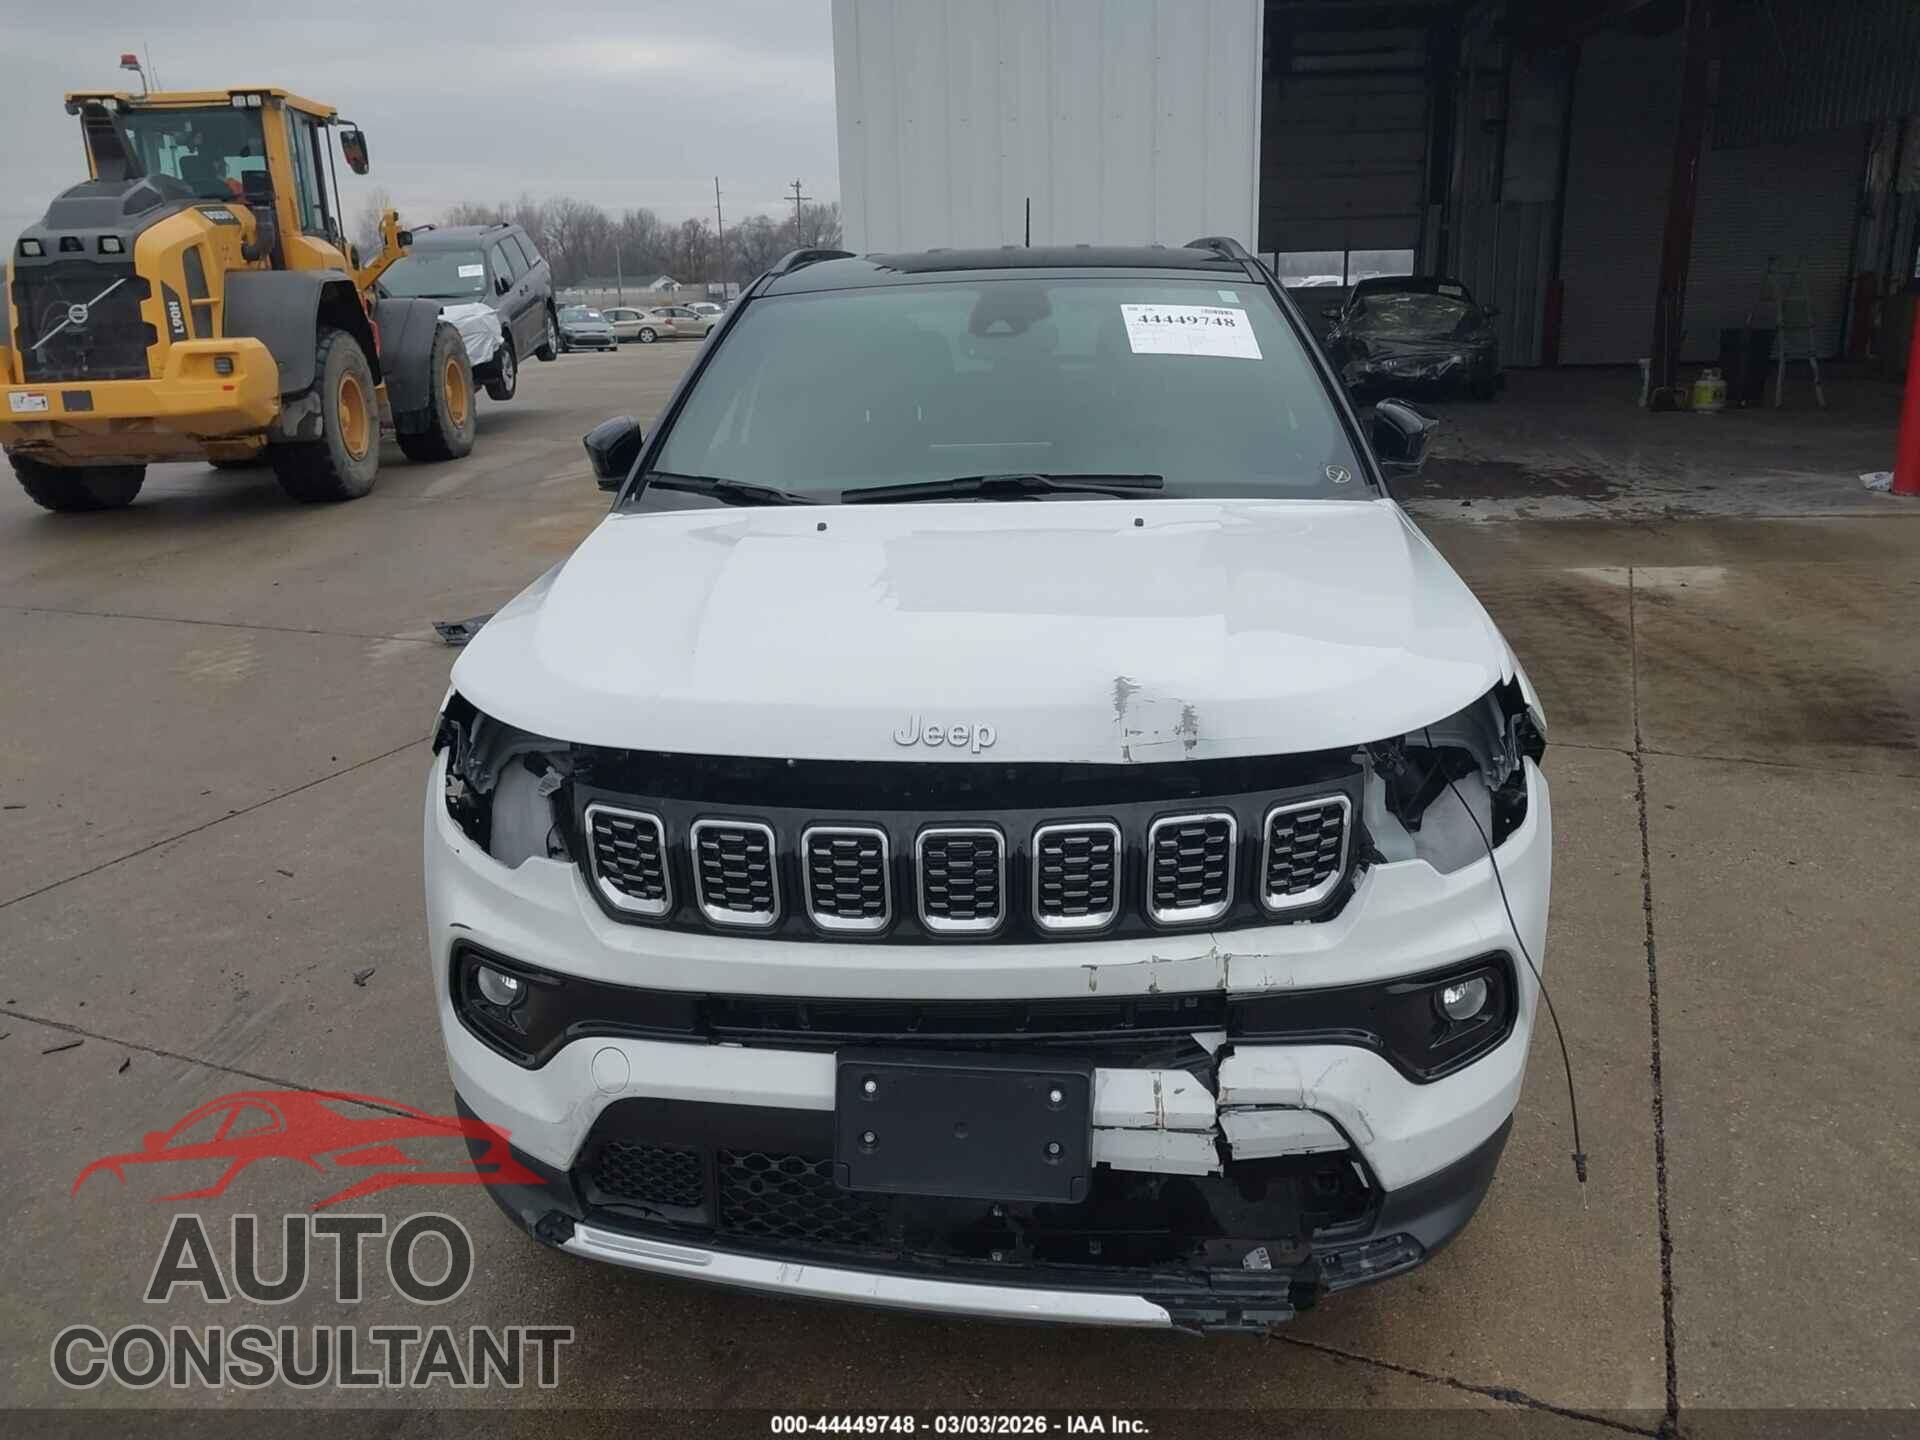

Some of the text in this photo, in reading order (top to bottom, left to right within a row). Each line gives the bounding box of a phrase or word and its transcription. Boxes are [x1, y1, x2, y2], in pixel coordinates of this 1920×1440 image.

[168, 301, 185, 333] L90H
[1138, 314, 1236, 327] 44449748
[893, 713, 997, 754] Jeep
